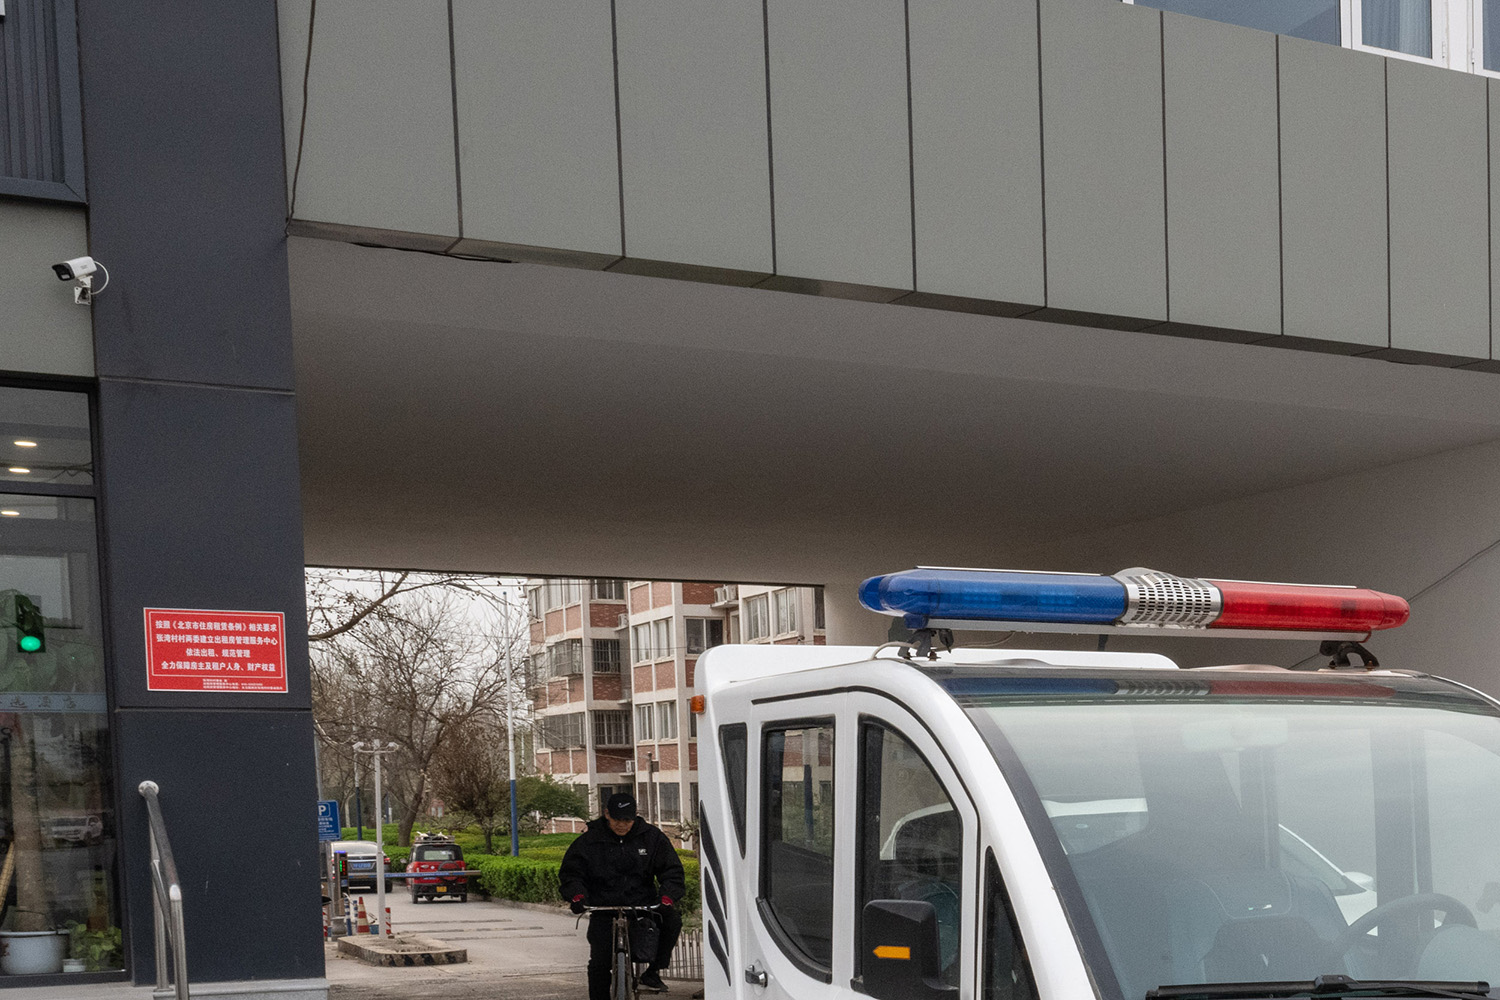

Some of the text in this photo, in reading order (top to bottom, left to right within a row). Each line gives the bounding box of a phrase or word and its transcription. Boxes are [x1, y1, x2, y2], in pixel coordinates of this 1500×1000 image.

[186, 648, 251, 658] 依法出租、规范管理
